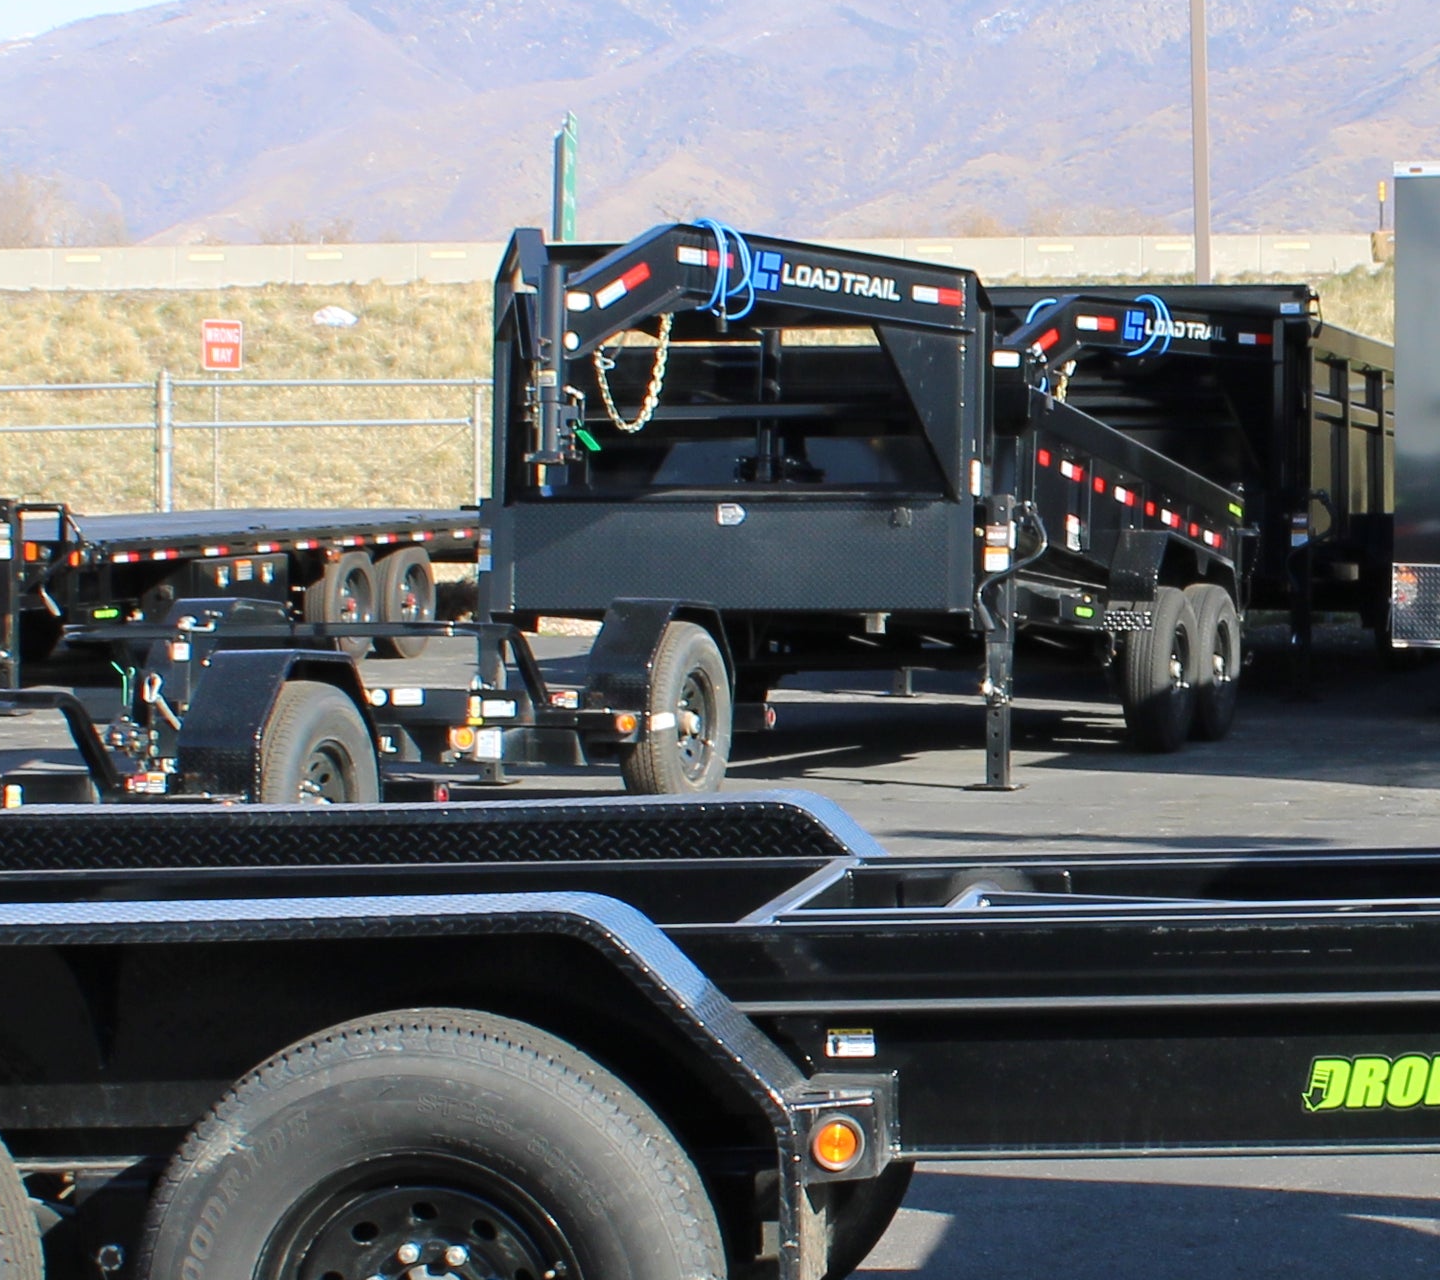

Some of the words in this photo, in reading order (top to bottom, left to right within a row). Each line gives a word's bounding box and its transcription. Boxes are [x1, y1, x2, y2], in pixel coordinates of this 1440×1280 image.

[781, 262, 842, 292] LOAD
[841, 271, 901, 302] TRAIL
[206, 327, 240, 343] WRONG
[212, 347, 233, 362] WAY
